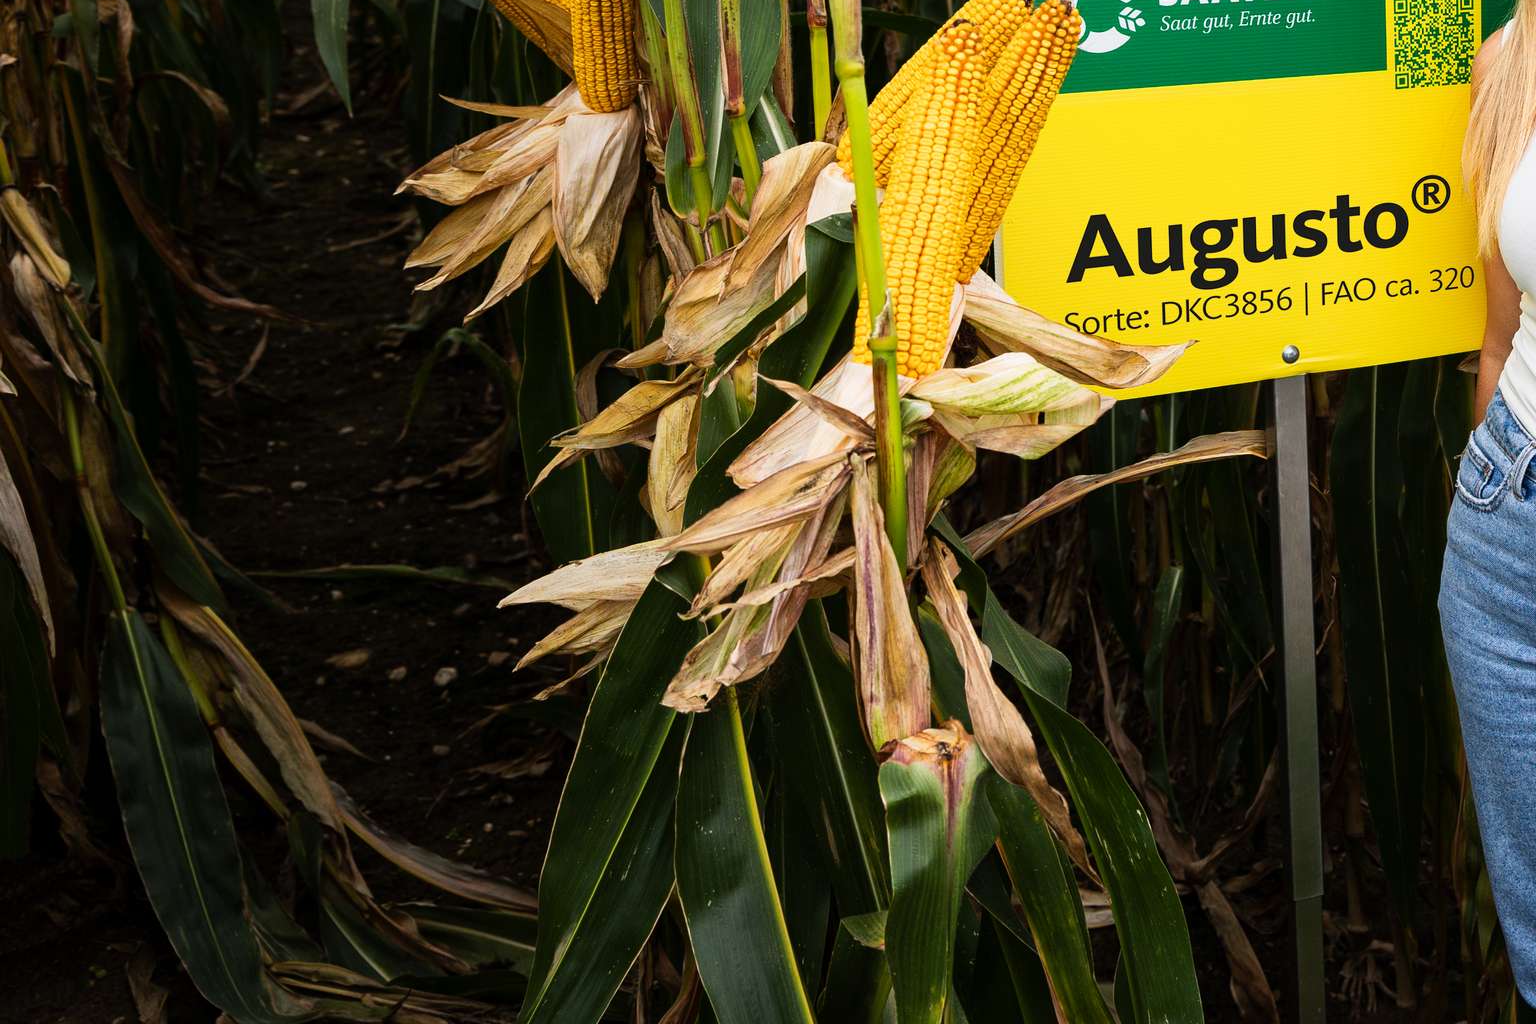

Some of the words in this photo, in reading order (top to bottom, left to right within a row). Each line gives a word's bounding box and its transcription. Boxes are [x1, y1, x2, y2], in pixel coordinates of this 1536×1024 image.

[1160, 15, 1198, 32] Saat
[1202, 14, 1234, 34] gut,
[1238, 10, 1282, 27] Ernte
[1285, 9, 1316, 29] gut.
[1064, 308, 1150, 336] Sorte:
[1161, 286, 1293, 326] DKC3856
[1321, 277, 1376, 306] FAO
[1385, 278, 1420, 298] ca.
[1429, 265, 1475, 293] 320
